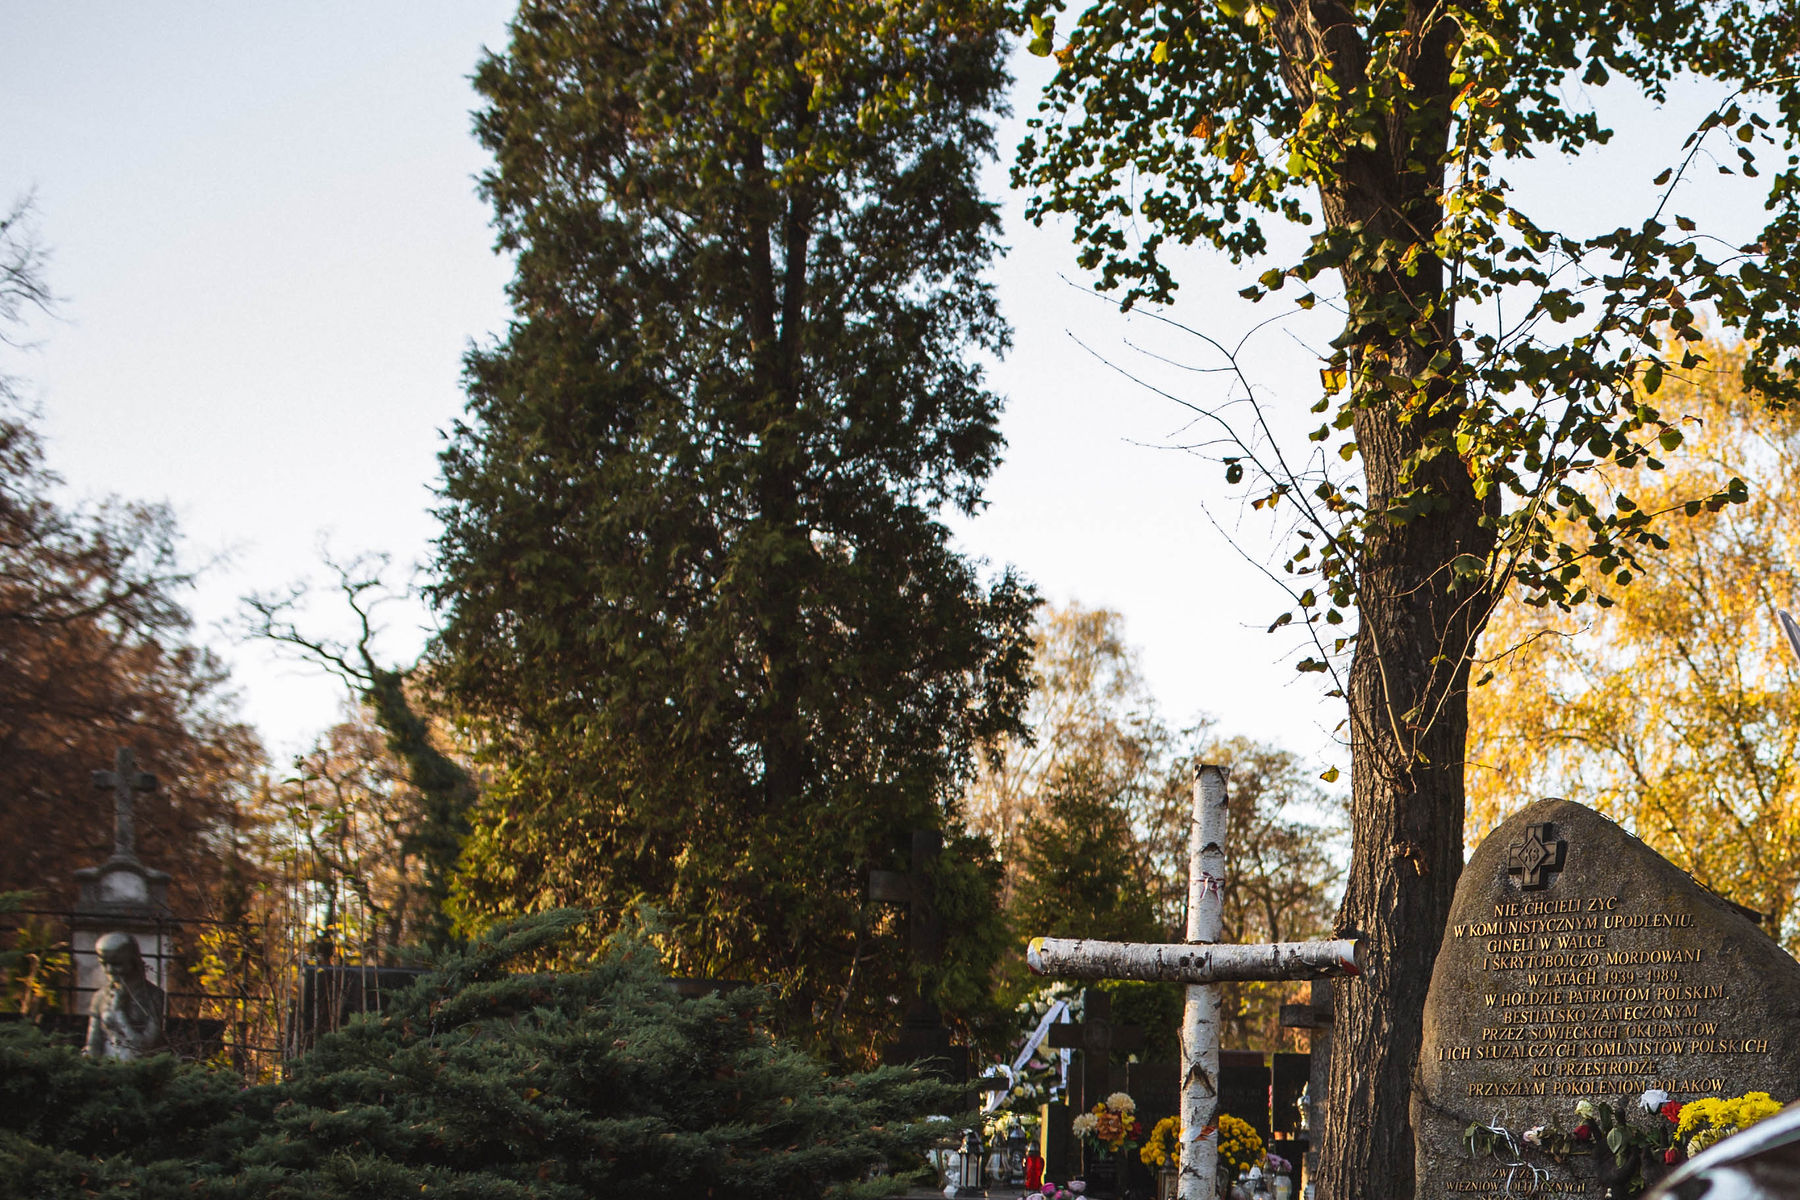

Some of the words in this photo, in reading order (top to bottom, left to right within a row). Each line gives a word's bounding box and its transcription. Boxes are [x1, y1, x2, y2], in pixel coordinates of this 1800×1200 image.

[1494, 903, 1519, 917] NIE
[1524, 899, 1582, 915] CHCIELI
[1454, 925, 1467, 938] W
[1470, 917, 1597, 937] KOMUNISTYCZNYM
[1604, 913, 1694, 929] UPODLENIU.
[1540, 938, 1552, 950] W
[1558, 934, 1606, 949] WALCE
[1483, 958, 1489, 971] I
[1606, 949, 1701, 965] MORDOWANI
[1528, 974, 1541, 987] W
[1544, 970, 1596, 986] LATACH
[1604, 970, 1634, 984] 1939
[1485, 993, 1497, 1007] W
[1569, 987, 1650, 1004] PATRIOTOM
[1504, 1008, 1586, 1024] BESTIALSKO
[1482, 1027, 1525, 1041] PRZEZ
[1530, 1025, 1618, 1040] SOWIECKICH
[1439, 1048, 1445, 1061] I
[1448, 1047, 1471, 1061] ICH
[1691, 1039, 1768, 1054] POLSKICH
[1533, 1063, 1552, 1077] KU
[1553, 1079, 1645, 1095] POKOLENIOM
